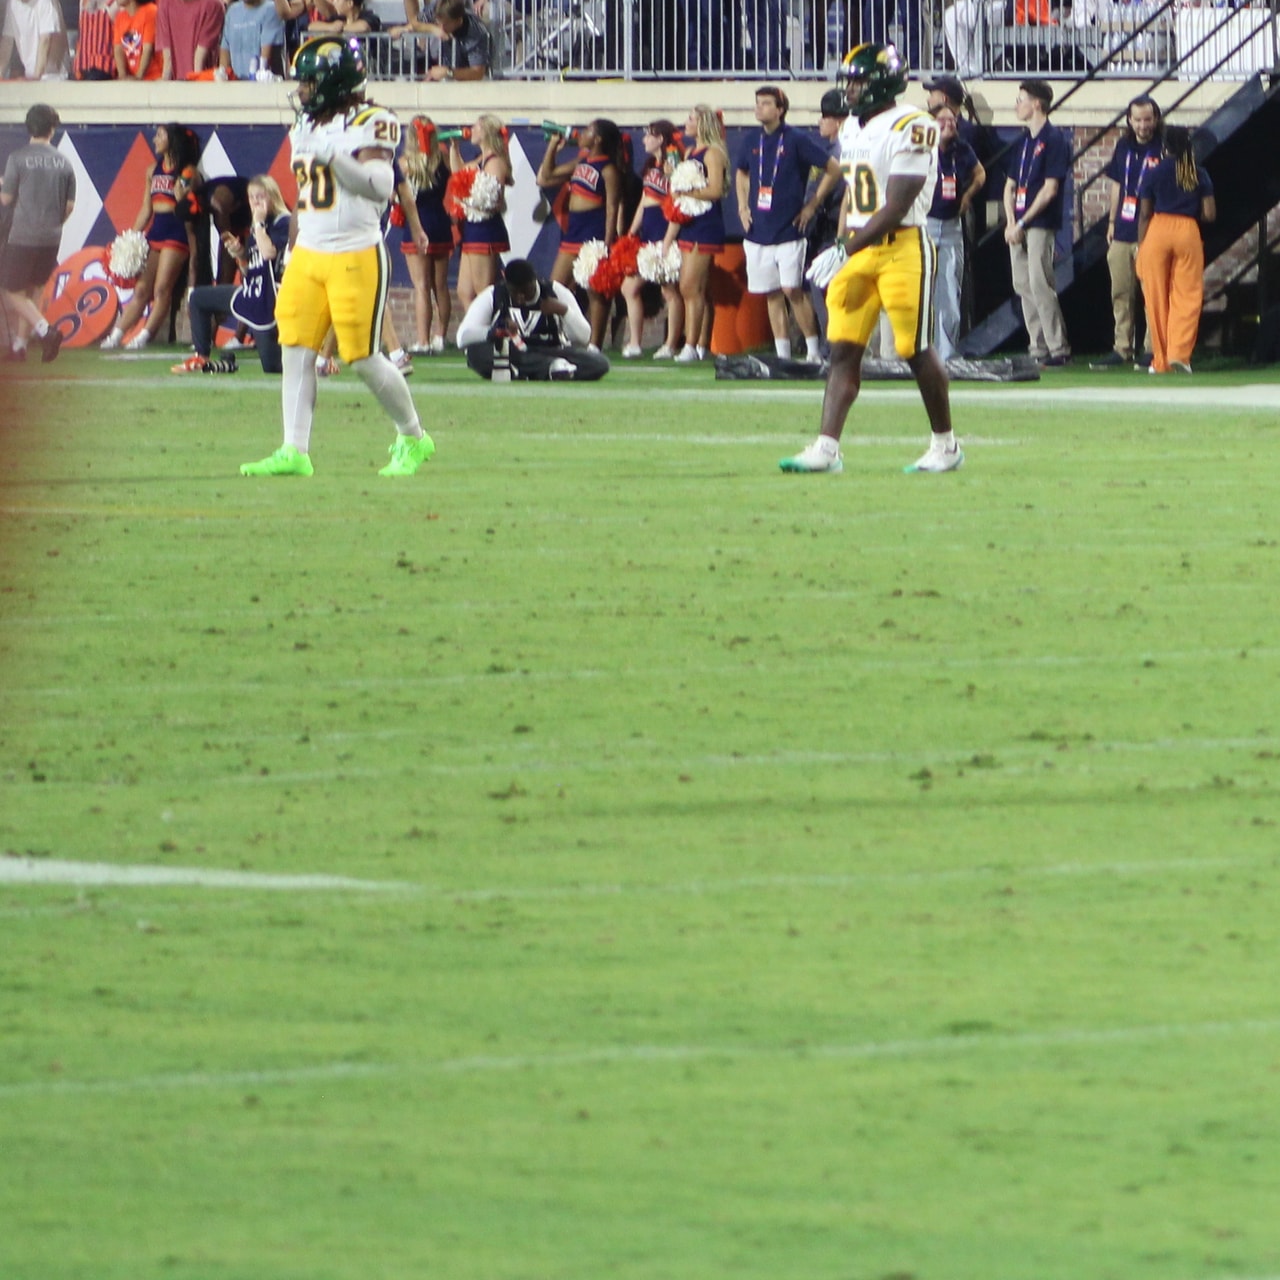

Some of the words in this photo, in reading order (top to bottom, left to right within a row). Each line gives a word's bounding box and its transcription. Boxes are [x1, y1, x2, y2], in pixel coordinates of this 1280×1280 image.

[374, 121, 398, 143] 20
[910, 124, 936, 143] 50
[26, 156, 66, 170] CREW
[293, 160, 335, 211] 20
